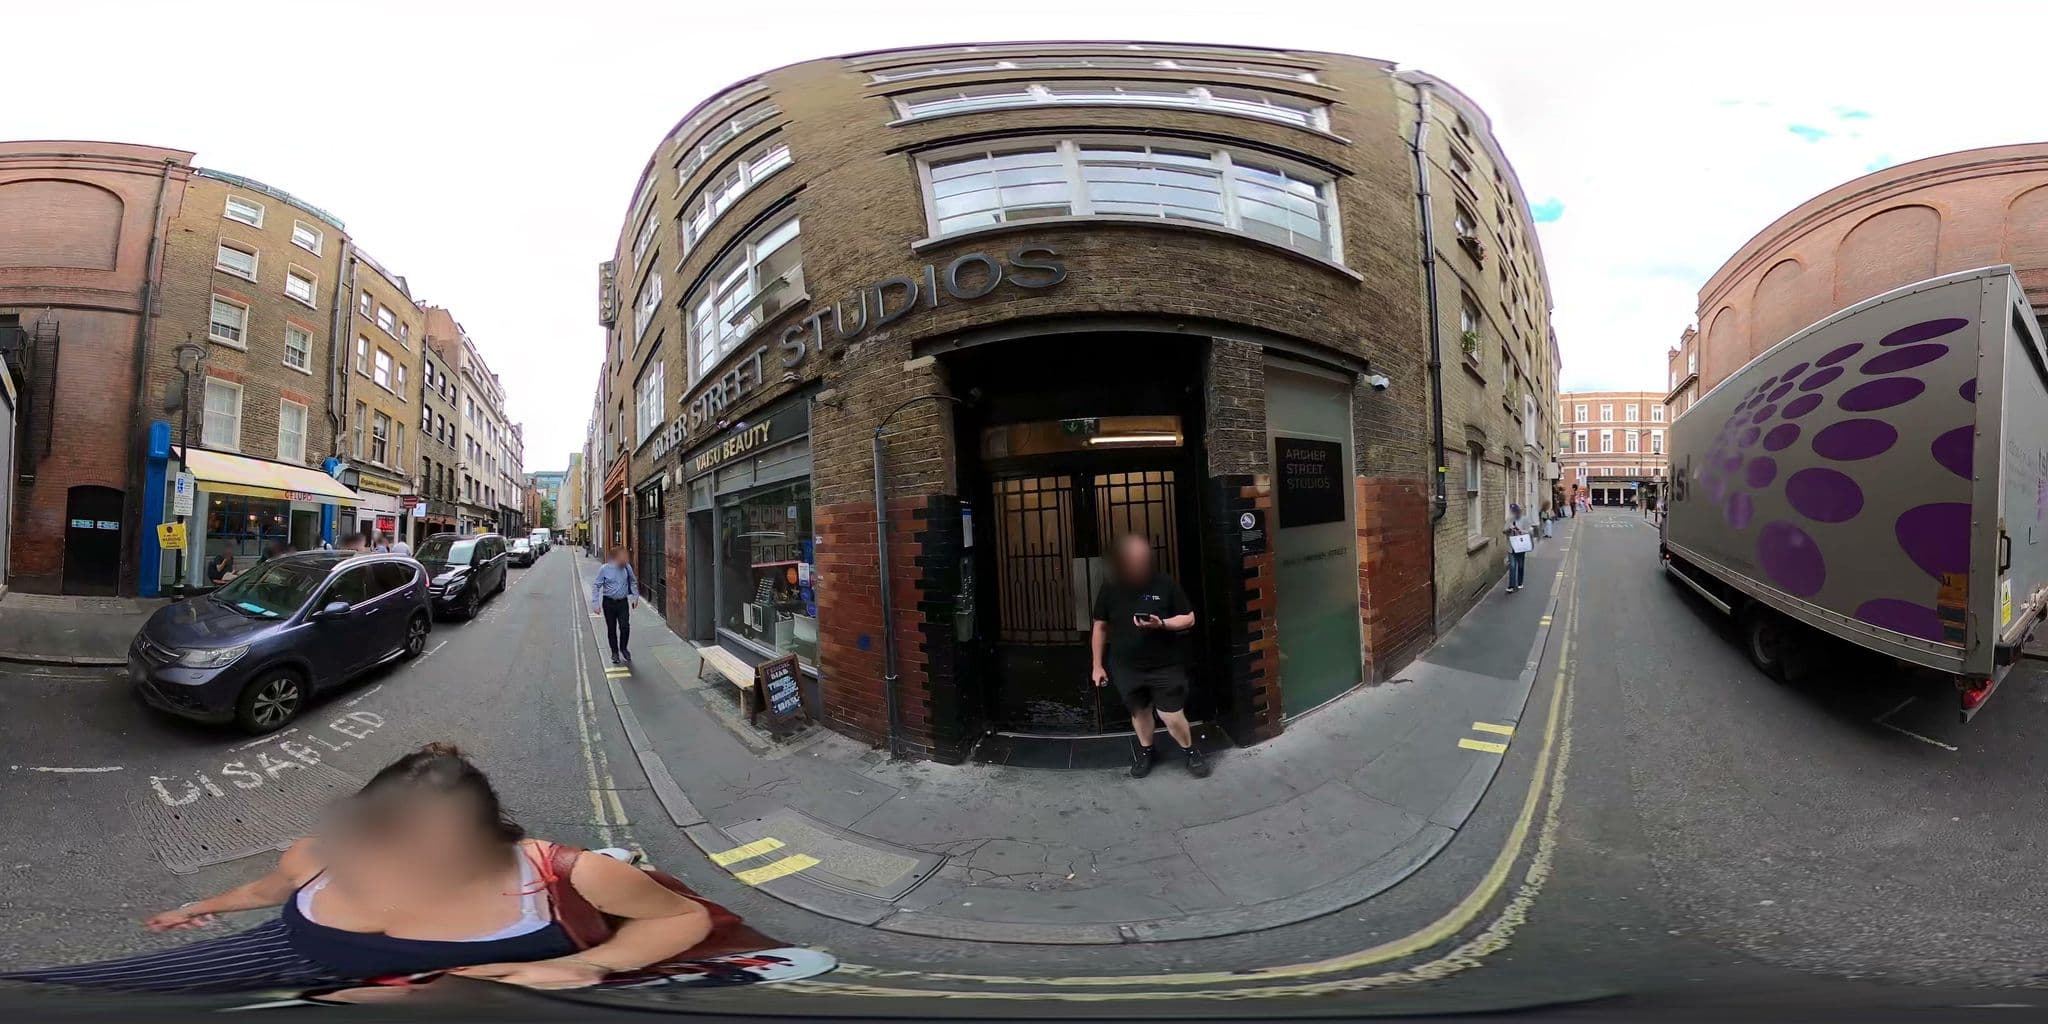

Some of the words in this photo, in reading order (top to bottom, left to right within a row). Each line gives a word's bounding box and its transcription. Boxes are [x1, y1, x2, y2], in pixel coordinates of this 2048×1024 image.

[651, 413, 689, 464] ARCHER
[690, 345, 768, 430] STREET
[781, 247, 1068, 368] STUDIOS
[723, 420, 771, 460] BEAUTY
[1286, 448, 1326, 461] ARCHER
[1286, 463, 1324, 475] STREET
[1287, 478, 1330, 489] STUDIOS
